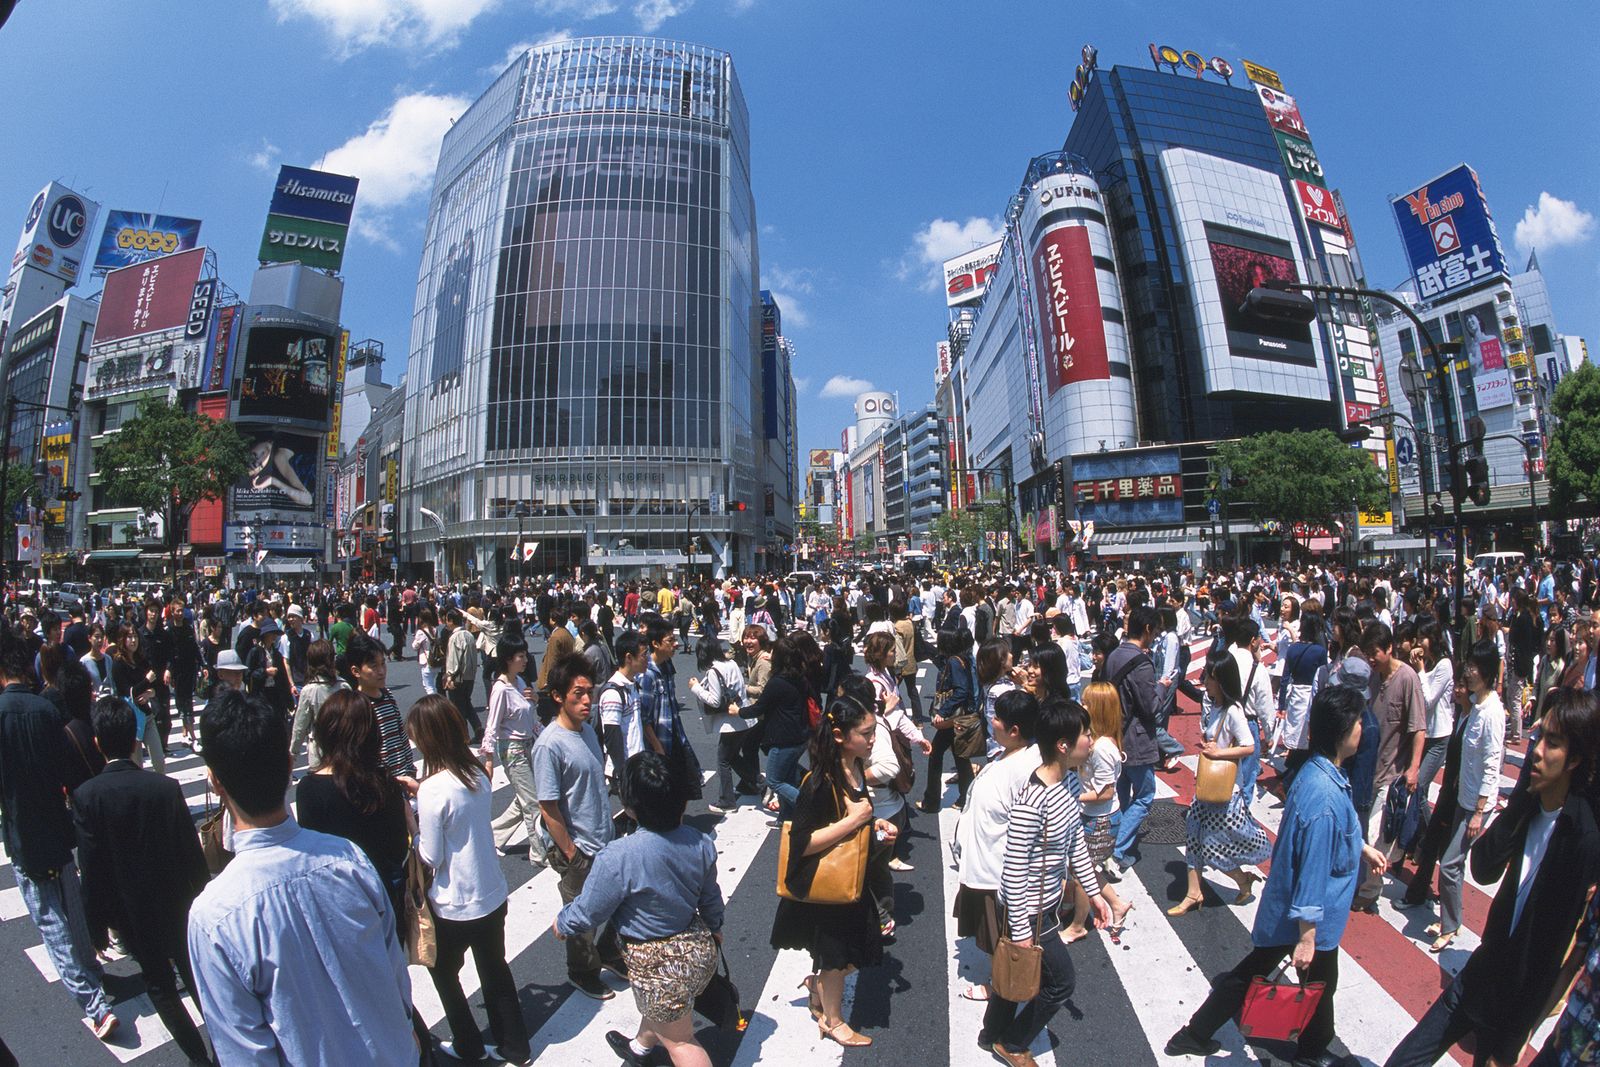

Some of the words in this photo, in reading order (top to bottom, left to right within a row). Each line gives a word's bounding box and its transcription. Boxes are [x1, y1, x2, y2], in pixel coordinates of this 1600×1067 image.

[537, 144, 693, 184] テレビ朝日
[1286, 150, 1323, 177] レイク
[280, 178, 355, 205] Hisamitsu
[1442, 191, 1464, 214] shop
[1304, 203, 1337, 224] アイフル
[122, 235, 174, 248] TOPY
[269, 231, 340, 253] サロンパス
[1416, 244, 1493, 298] 武富士
[187, 283, 211, 335] SEED
[1258, 338, 1287, 350] Panasonic
[1333, 323, 1348, 371] レイク
[535, 473, 609, 483] STARBUCKS
[619, 472, 664, 482] COFFEE
[1078, 475, 1175, 500] 三千里薬品
[1519, 487, 1530, 497] JR
[234, 531, 267, 540] TOKO
